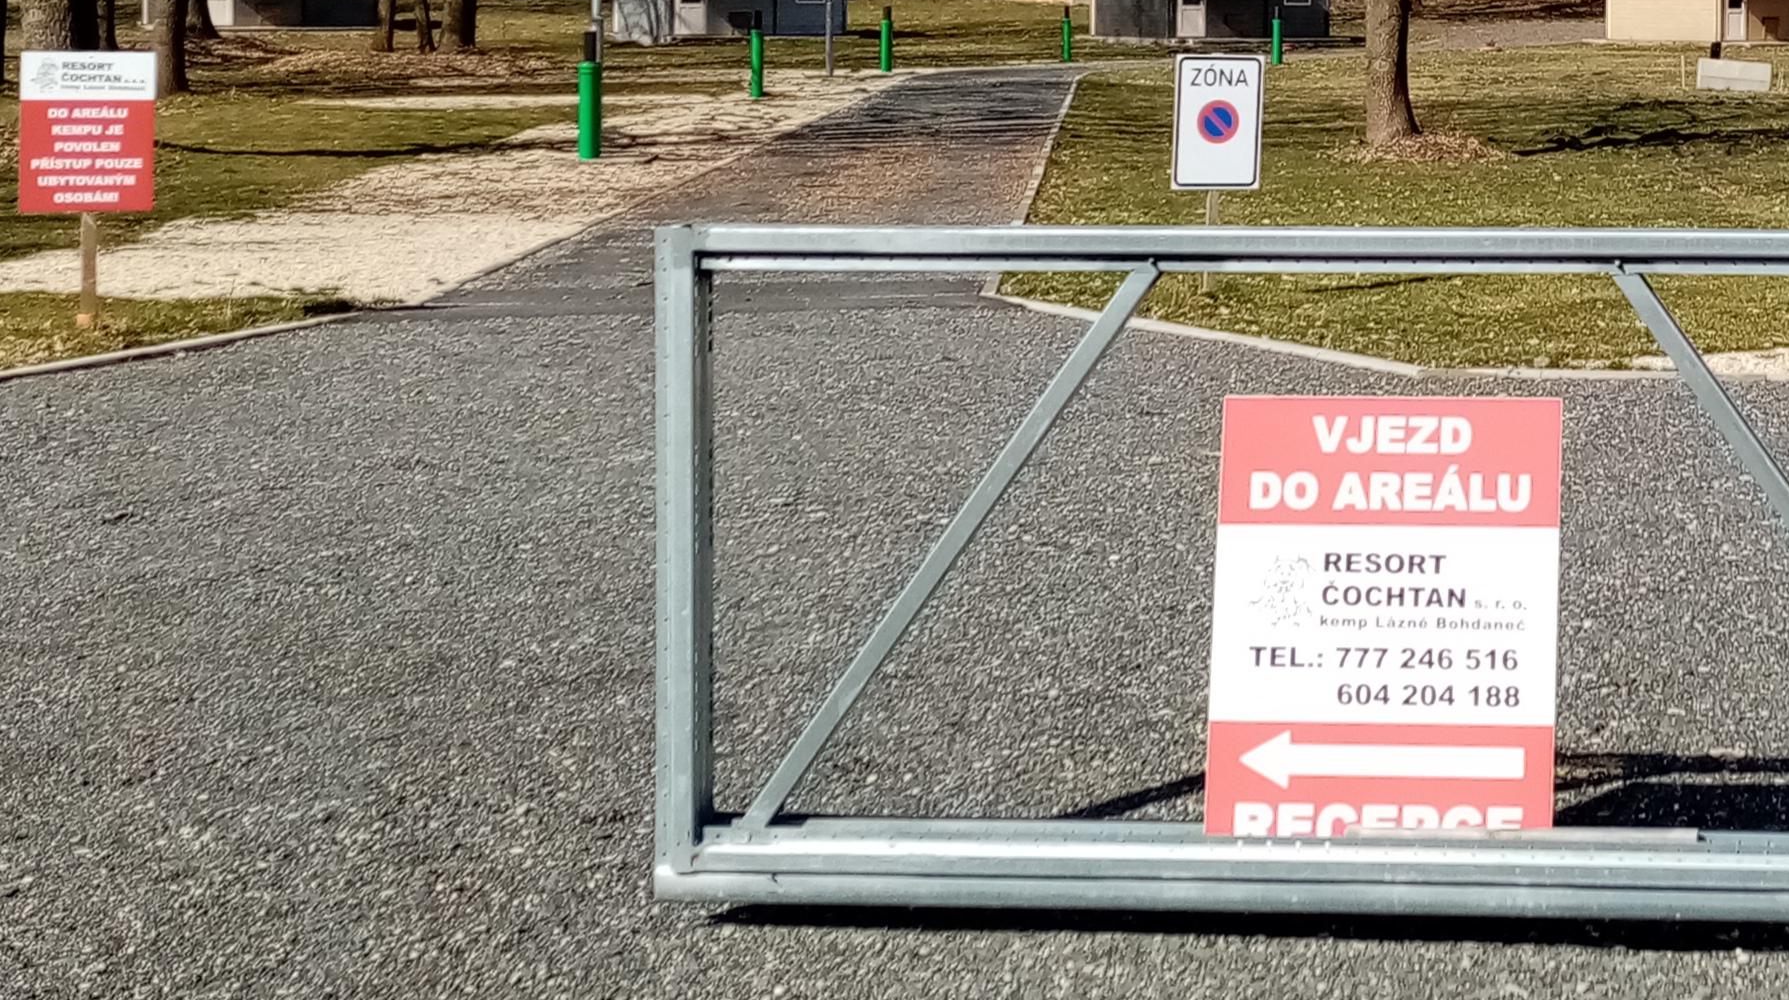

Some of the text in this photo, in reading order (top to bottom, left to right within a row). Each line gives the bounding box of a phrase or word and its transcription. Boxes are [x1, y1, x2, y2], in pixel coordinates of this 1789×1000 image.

[62, 61, 114, 70] RESORT
[1190, 63, 1248, 87] ZÓNA
[47, 106, 129, 119] DO AREÁLU
[51, 125, 124, 136] KEMPU JE
[54, 141, 121, 153] POVOLEN
[30, 156, 144, 170] PŘÍSTUP POUZE
[37, 173, 137, 187] UBYTOVANÝM
[1312, 414, 1473, 455] VJEZD
[1248, 464, 1532, 513] DO AREÁLU
[1323, 552, 1447, 575] RESORT
[1321, 580, 1467, 608] ČOCHTAN
[1319, 615, 1368, 631] kemp
[1249, 646, 1519, 671] TEL.: 777 246 516
[1336, 683, 1521, 708] 604 204 188
